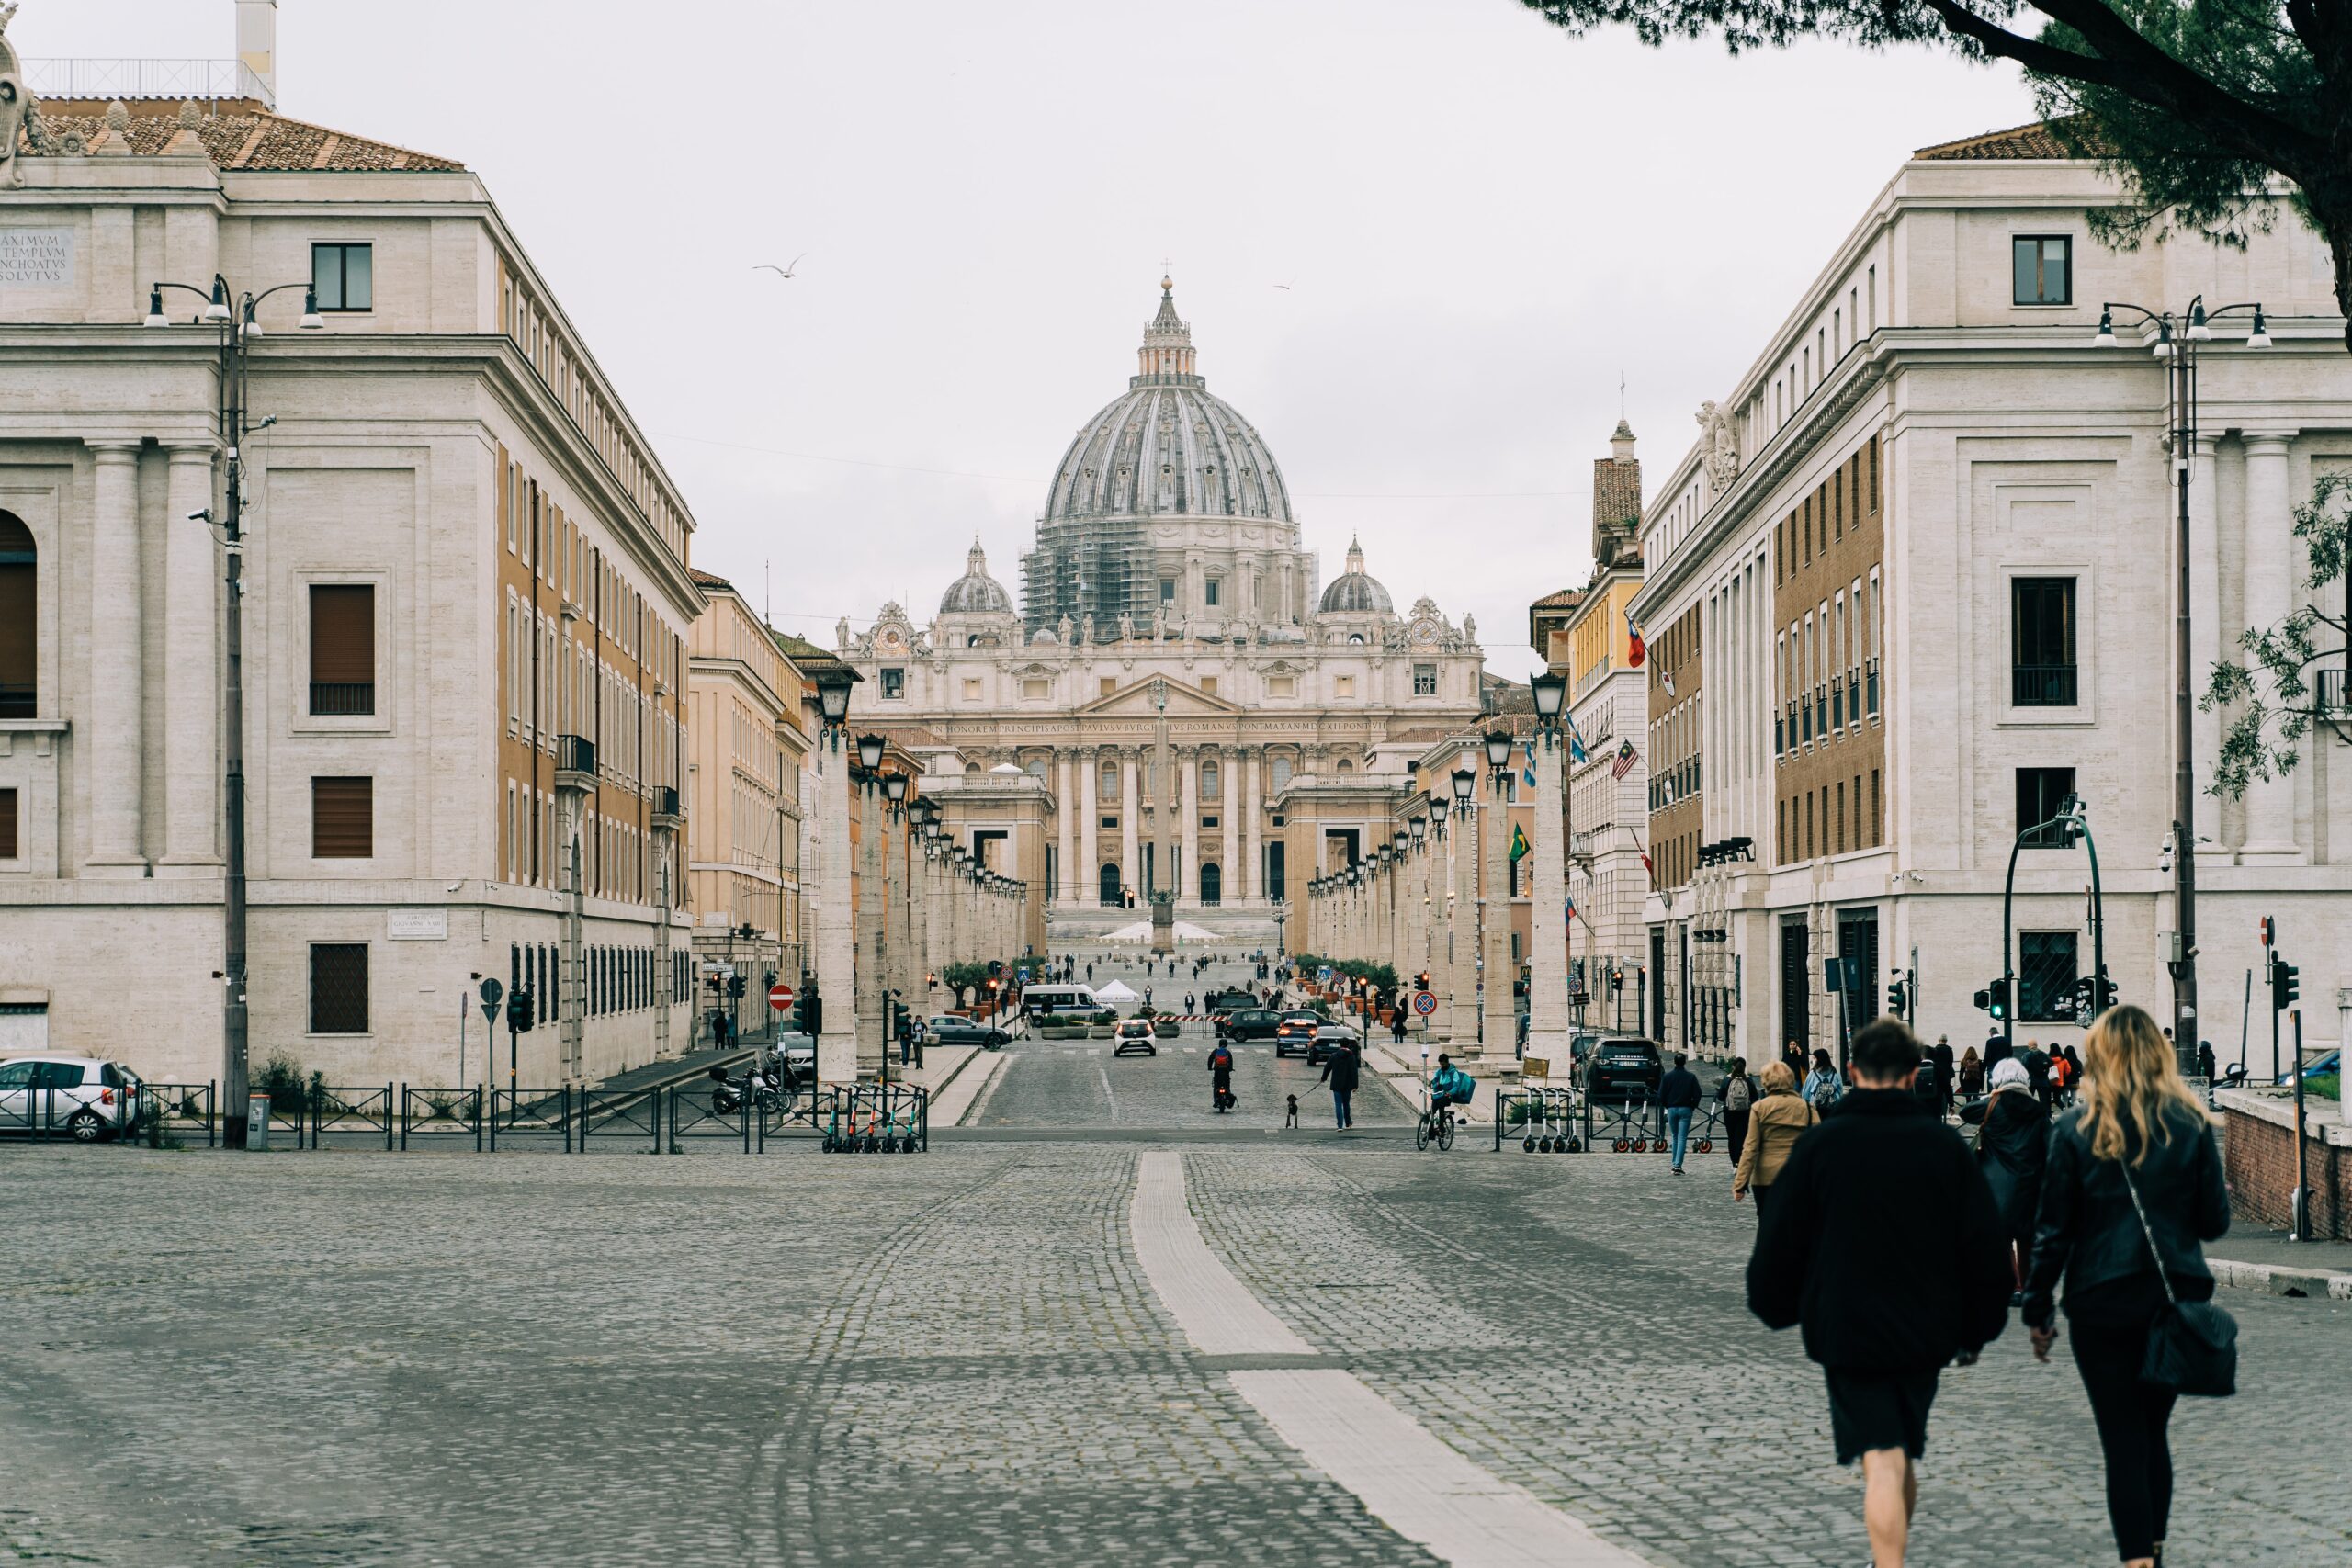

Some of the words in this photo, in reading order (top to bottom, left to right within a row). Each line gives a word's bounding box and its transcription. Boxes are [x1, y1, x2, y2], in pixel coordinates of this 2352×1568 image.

[2, 247, 66, 258] TEMPLVM
[1187, 723, 1237, 731] ROMANVS
[1372, 721, 1385, 730] VII
